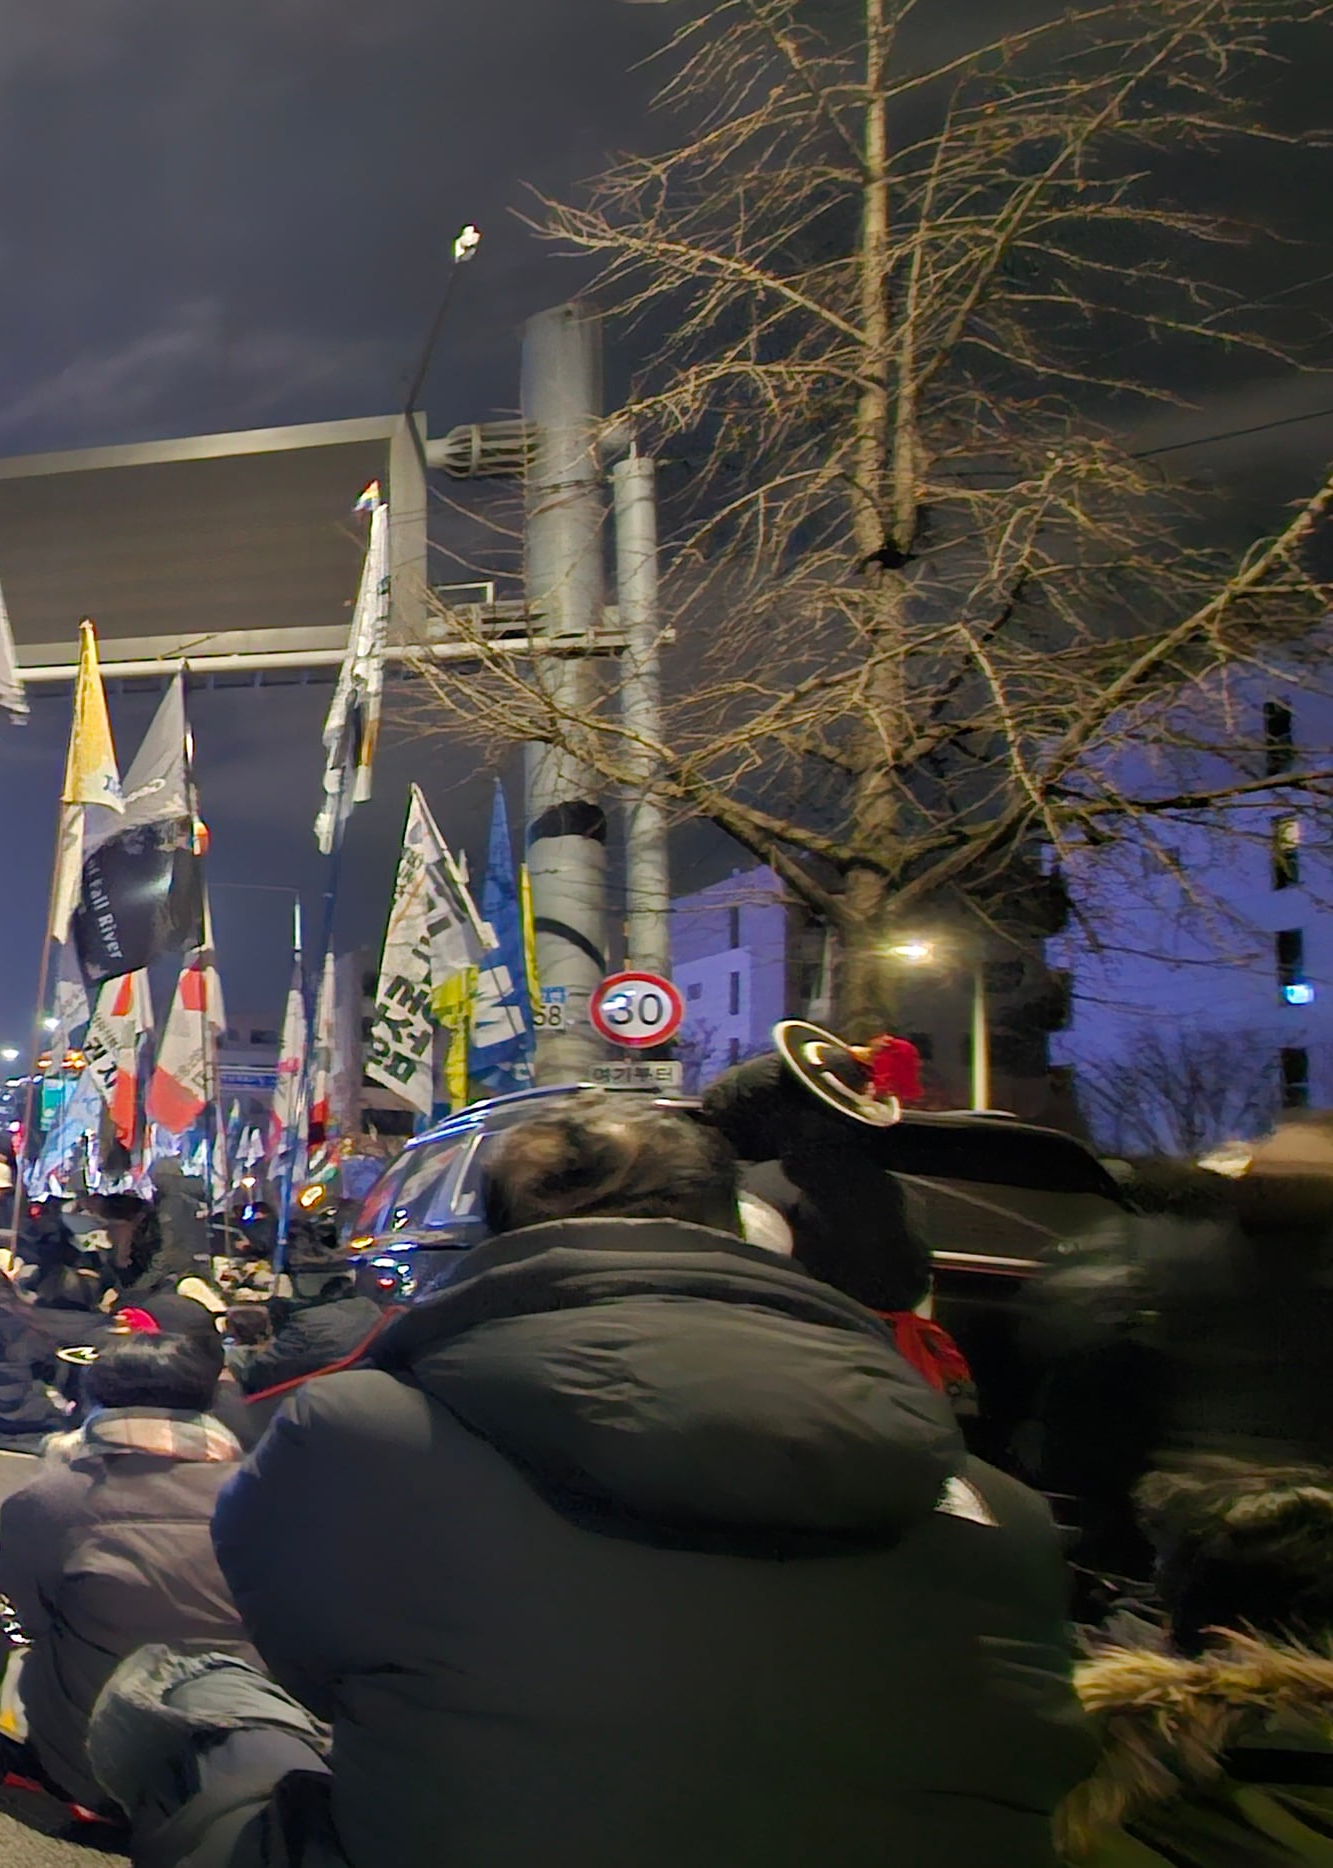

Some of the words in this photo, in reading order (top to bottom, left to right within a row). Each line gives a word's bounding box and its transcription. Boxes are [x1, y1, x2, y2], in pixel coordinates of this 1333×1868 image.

[98, 914, 124, 959] River
[606, 992, 664, 1026] 30
[593, 1067, 673, 1082] 여기부터
